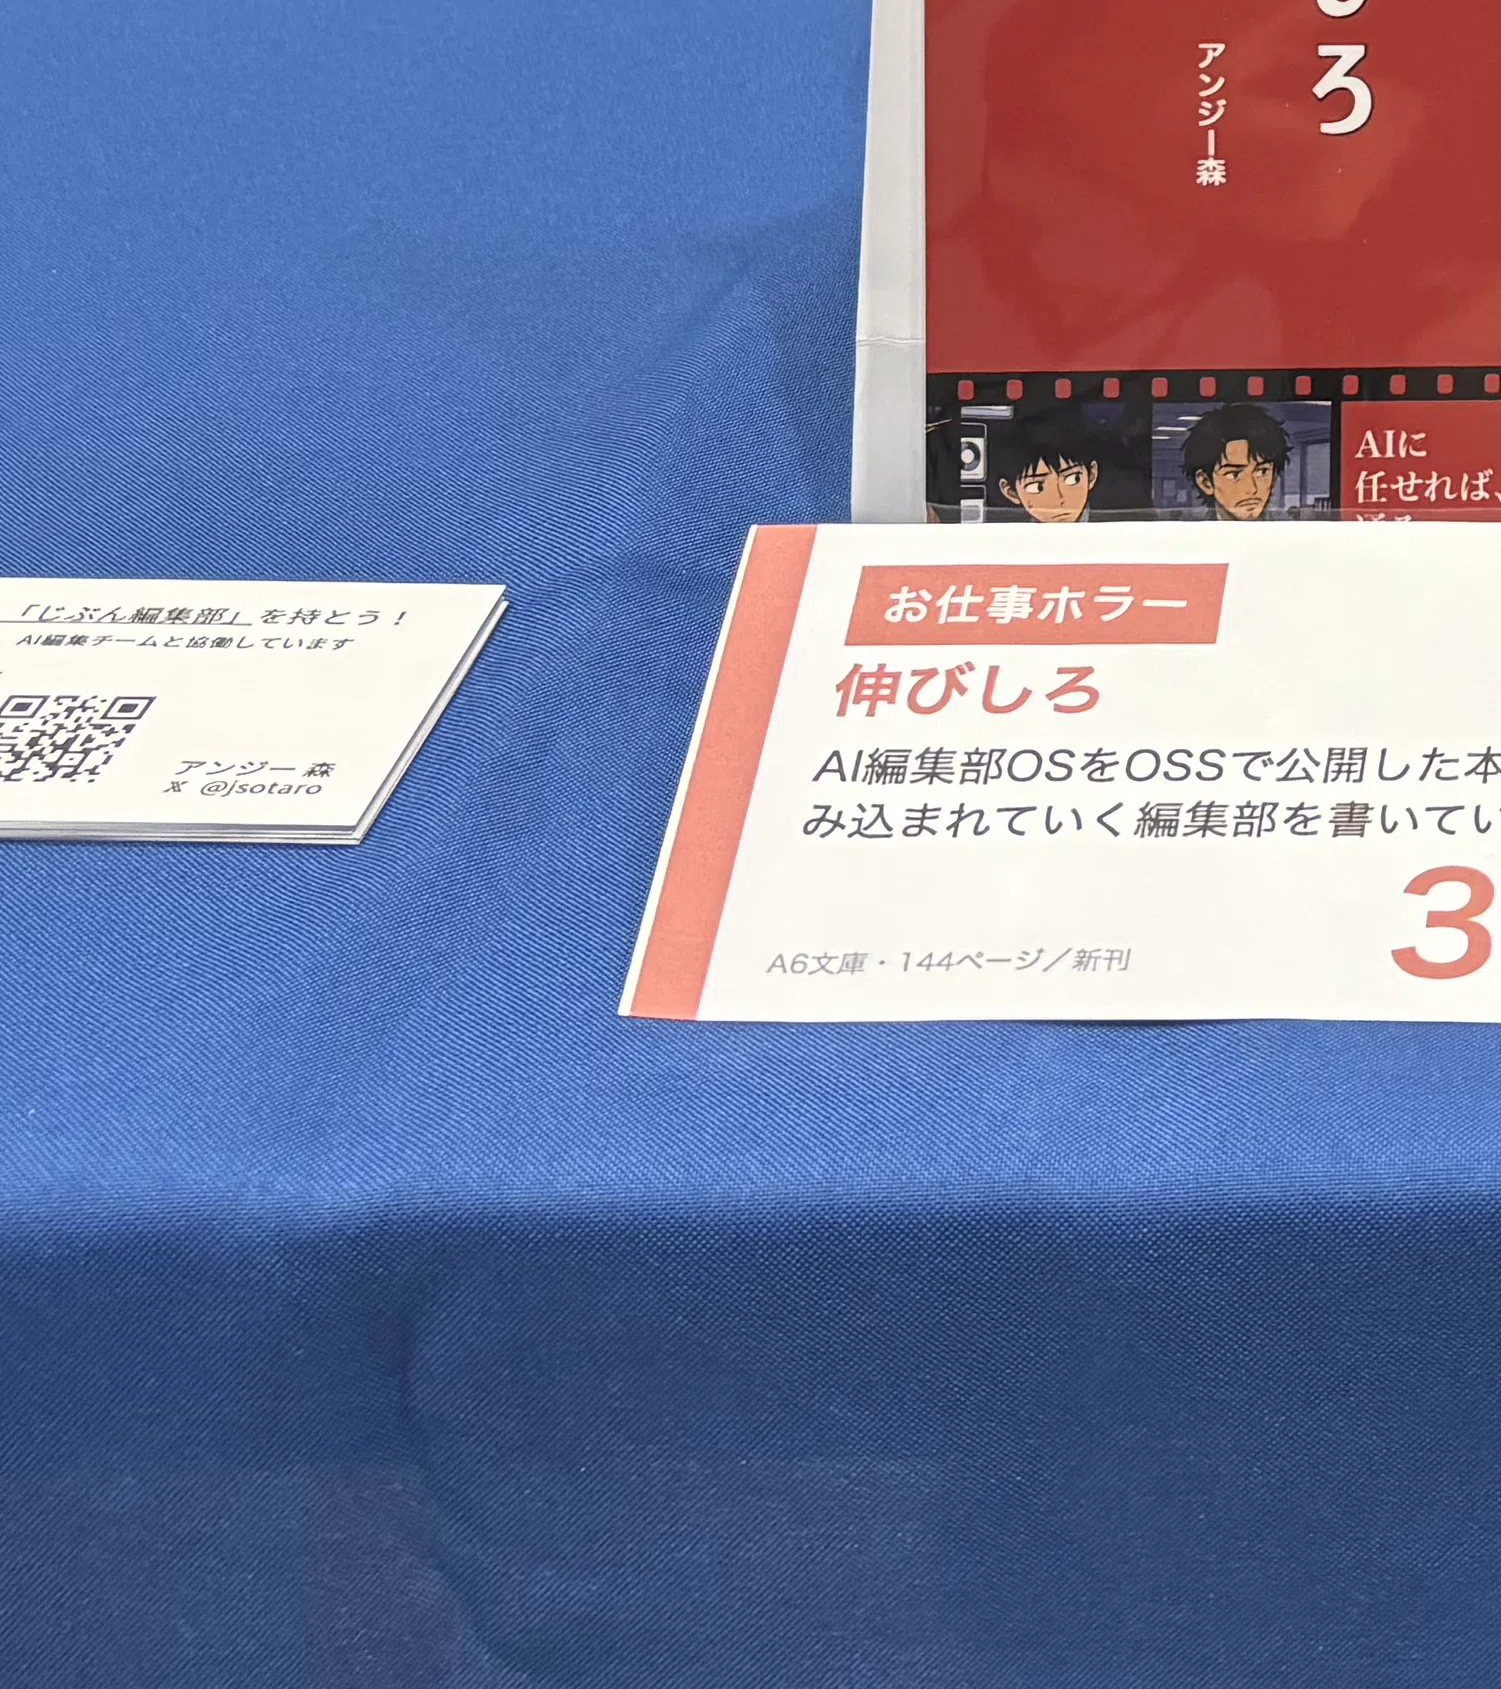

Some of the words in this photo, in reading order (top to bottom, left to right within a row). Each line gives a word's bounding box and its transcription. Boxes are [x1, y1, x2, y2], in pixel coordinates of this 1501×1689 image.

[1196, 44, 1226, 186] アンジー森
[1355, 430, 1426, 458] AIに
[884, 585, 1187, 624] お仕事ホラー
[836, 661, 1099, 717] 伸びしろ
[200, 780, 322, 797] @jsotaro
